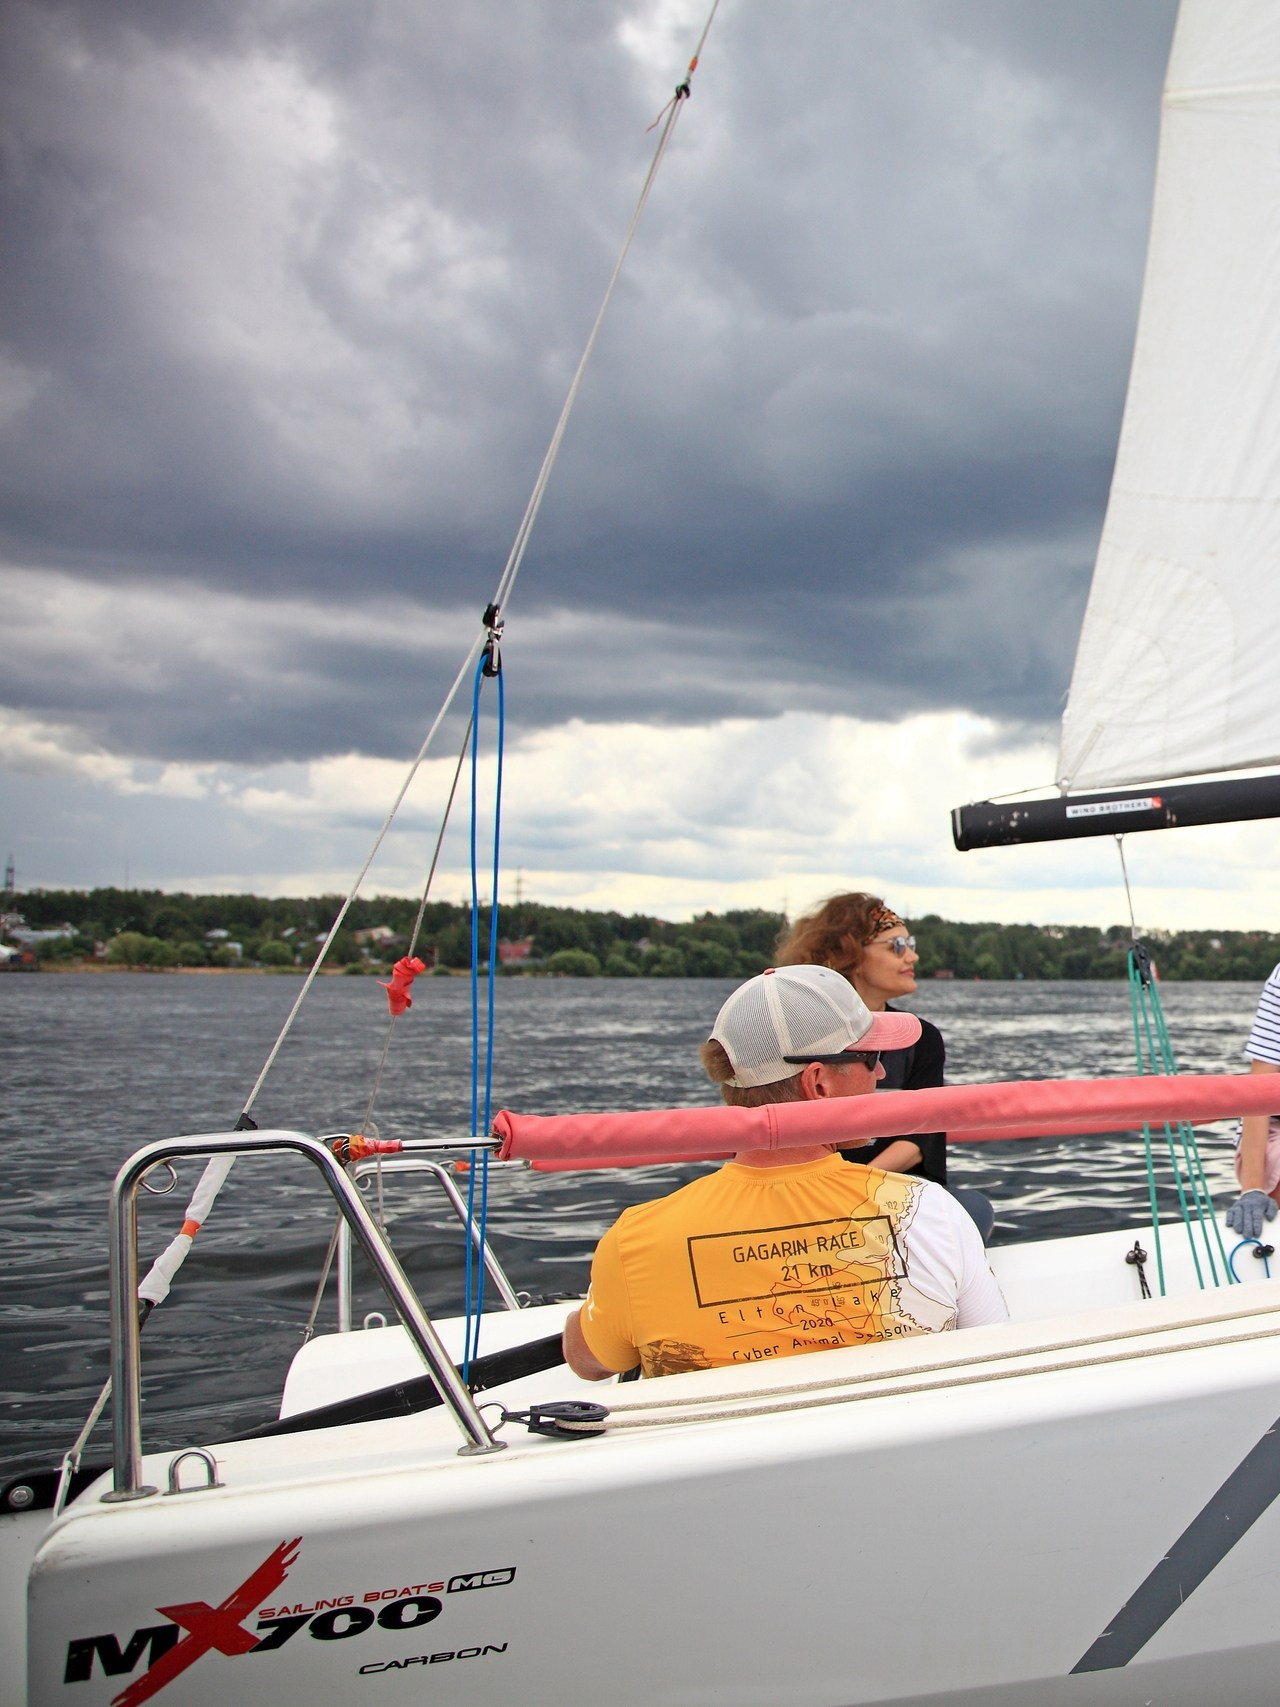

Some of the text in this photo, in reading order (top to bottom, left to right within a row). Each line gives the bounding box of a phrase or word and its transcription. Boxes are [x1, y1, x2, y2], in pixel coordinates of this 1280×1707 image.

[733, 1239, 808, 1263] GAGARIN
[816, 1231, 860, 1253] RACE
[781, 1263, 833, 1281] 21 km
[801, 1317, 834, 1331] 2020
[258, 1596, 354, 1619] SAILING
[363, 1581, 445, 1603] BOATS
[358, 1642, 509, 1675] CARBON
